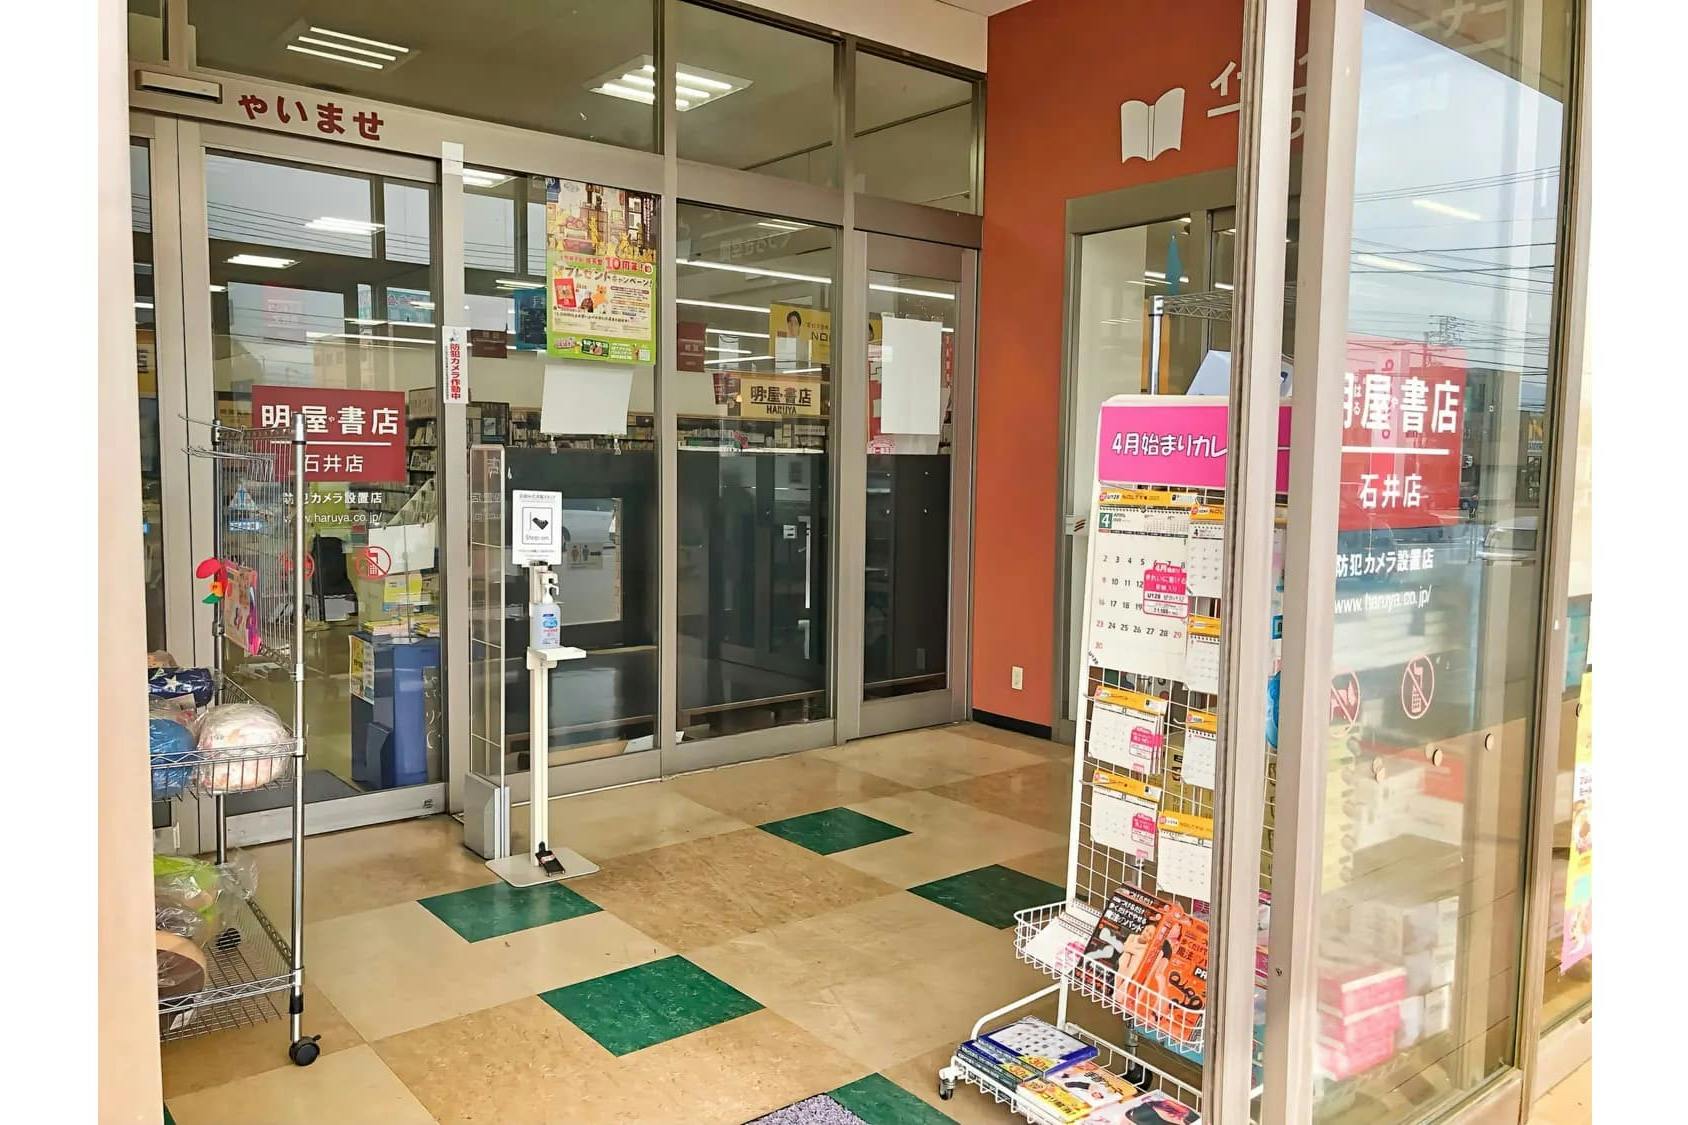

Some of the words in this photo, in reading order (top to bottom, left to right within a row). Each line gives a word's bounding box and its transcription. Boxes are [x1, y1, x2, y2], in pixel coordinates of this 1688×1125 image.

[238, 95, 384, 140] やいませ
[450, 343, 461, 399] 防犯カメラ作動中
[751, 385, 812, 404] 明屋書店
[1343, 372, 1460, 433] 屋書店
[261, 404, 399, 436] 明屋書店
[1111, 431, 1228, 458] 4月始まりカレ
[304, 453, 364, 473] 石井店
[1360, 473, 1422, 509] 石井店
[1101, 513, 1111, 528] 4
[1115, 556, 1120, 564] 3
[1140, 558, 1145, 566] 5
[1336, 548, 1434, 578] 防犯カメラ設置店
[1136, 581, 1143, 589] 12
[1110, 600, 1117, 608] 17
[1133, 625, 1141, 633] 26
[1146, 627, 1155, 635] 27
[1159, 629, 1168, 637] 28
